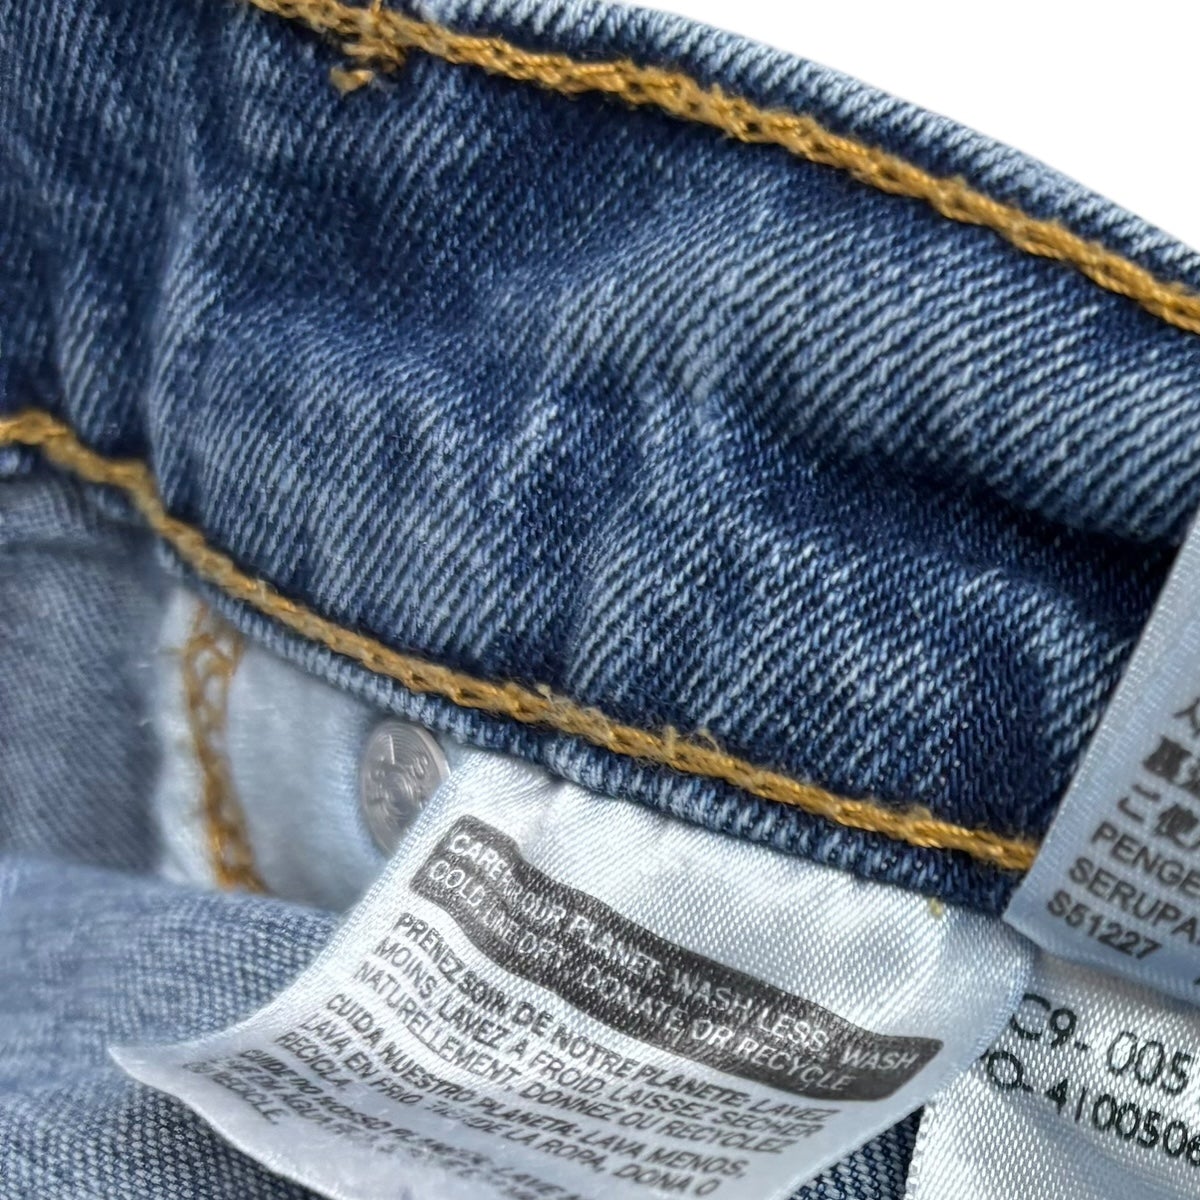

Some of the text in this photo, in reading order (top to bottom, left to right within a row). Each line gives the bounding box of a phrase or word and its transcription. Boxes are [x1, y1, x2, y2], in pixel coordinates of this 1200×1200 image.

[1043, 887, 1164, 963] S51227
[391, 908, 467, 985] PRENEZ
[454, 966, 514, 1019] SOIN
[511, 1000, 554, 1038] DE
[547, 1021, 639, 1080] NOTRE
[670, 968, 755, 1022] WASH
[842, 1044, 916, 1066] WASH
[300, 1010, 353, 1056] LAVA
[343, 1046, 381, 1080] EN
[535, 1135, 608, 1174] ROPA,
[611, 1158, 693, 1191] DONA
[324, 992, 387, 1051] CUIDA
[377, 1038, 478, 1106] NUESTRO
[577, 1128, 648, 1162] LAVA
[645, 1145, 749, 1180] MENOS,
[436, 994, 512, 1051] LAVEZ
[527, 1047, 606, 1101] FROID,
[606, 1083, 719, 1123] LAISSEZ
[692, 1018, 733, 1046] OR
[733, 1037, 857, 1096] RECYCLE
[518, 1080, 626, 1125] DONNEZ
[618, 1111, 663, 1132] OU
[655, 1119, 799, 1157] RECYCLEZ
